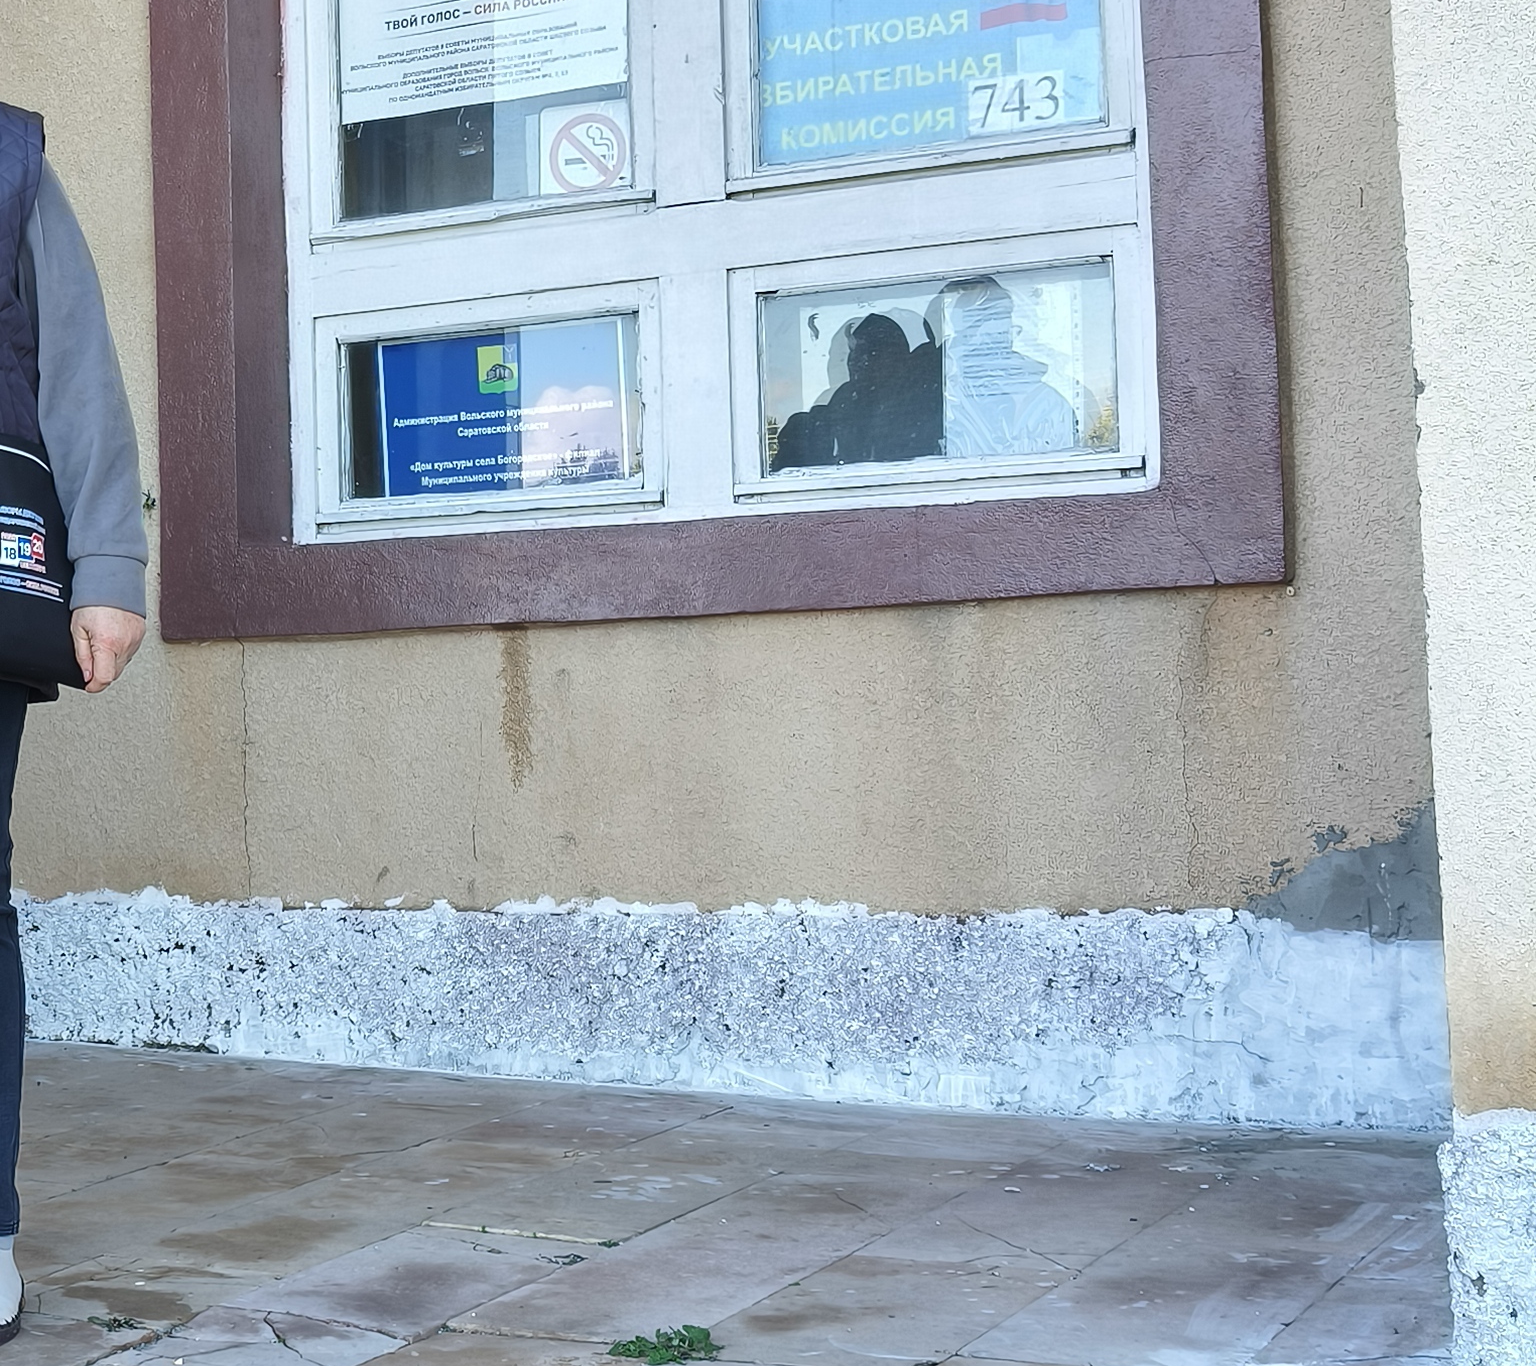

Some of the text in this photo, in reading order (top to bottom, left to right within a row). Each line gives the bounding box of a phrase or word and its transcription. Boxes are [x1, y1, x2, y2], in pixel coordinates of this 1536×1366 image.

[384, 15, 418, 31] ТВОЙ
[421, 8, 460, 26] ГОЛОС
[474, 1, 511, 15] СИЛА
[763, 9, 968, 60] УЧАСТКОВАЯ
[971, 75, 1059, 128] 743
[781, 107, 955, 150] КОМИССИЯ
[460, 410, 505, 422] Вольского
[457, 423, 512, 438] Саратовской
[434, 459, 473, 472] культуры
[475, 457, 495, 466] села
[421, 473, 492, 488] Муниципального
[4, 539, 43, 560] 18 19 20
